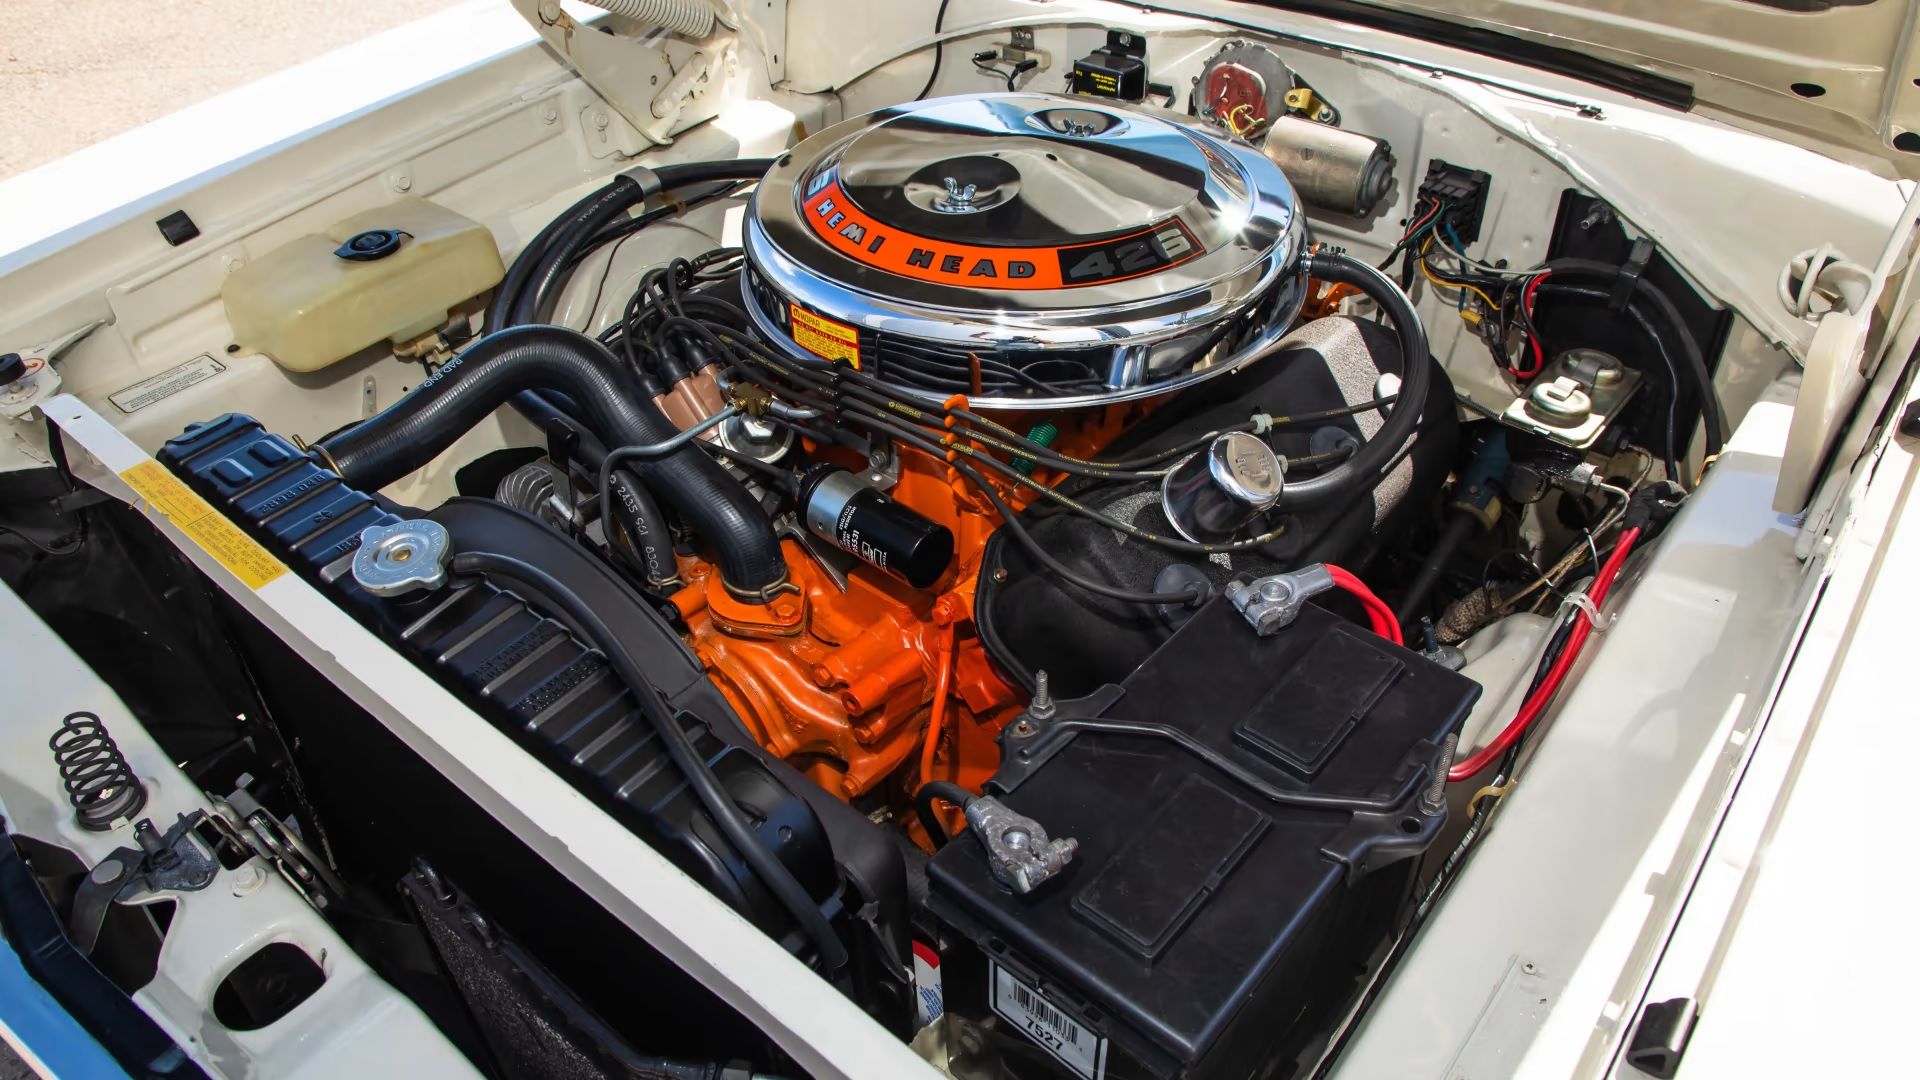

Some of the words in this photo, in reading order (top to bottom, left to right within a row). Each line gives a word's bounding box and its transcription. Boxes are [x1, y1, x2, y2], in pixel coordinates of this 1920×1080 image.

[816, 198, 886, 254] HEMI
[906, 248, 1036, 279] HEAD
[1069, 228, 1191, 278] 426
[800, 312, 820, 328] MOPAR
[966, 431, 999, 447] ELECTRONIC
[1000, 443, 1038, 461] SUPPRESSION
[1015, 473, 1048, 493] ELECTRONIC
[617, 486, 638, 513] 2435
[1024, 1016, 1063, 1051] 7527
